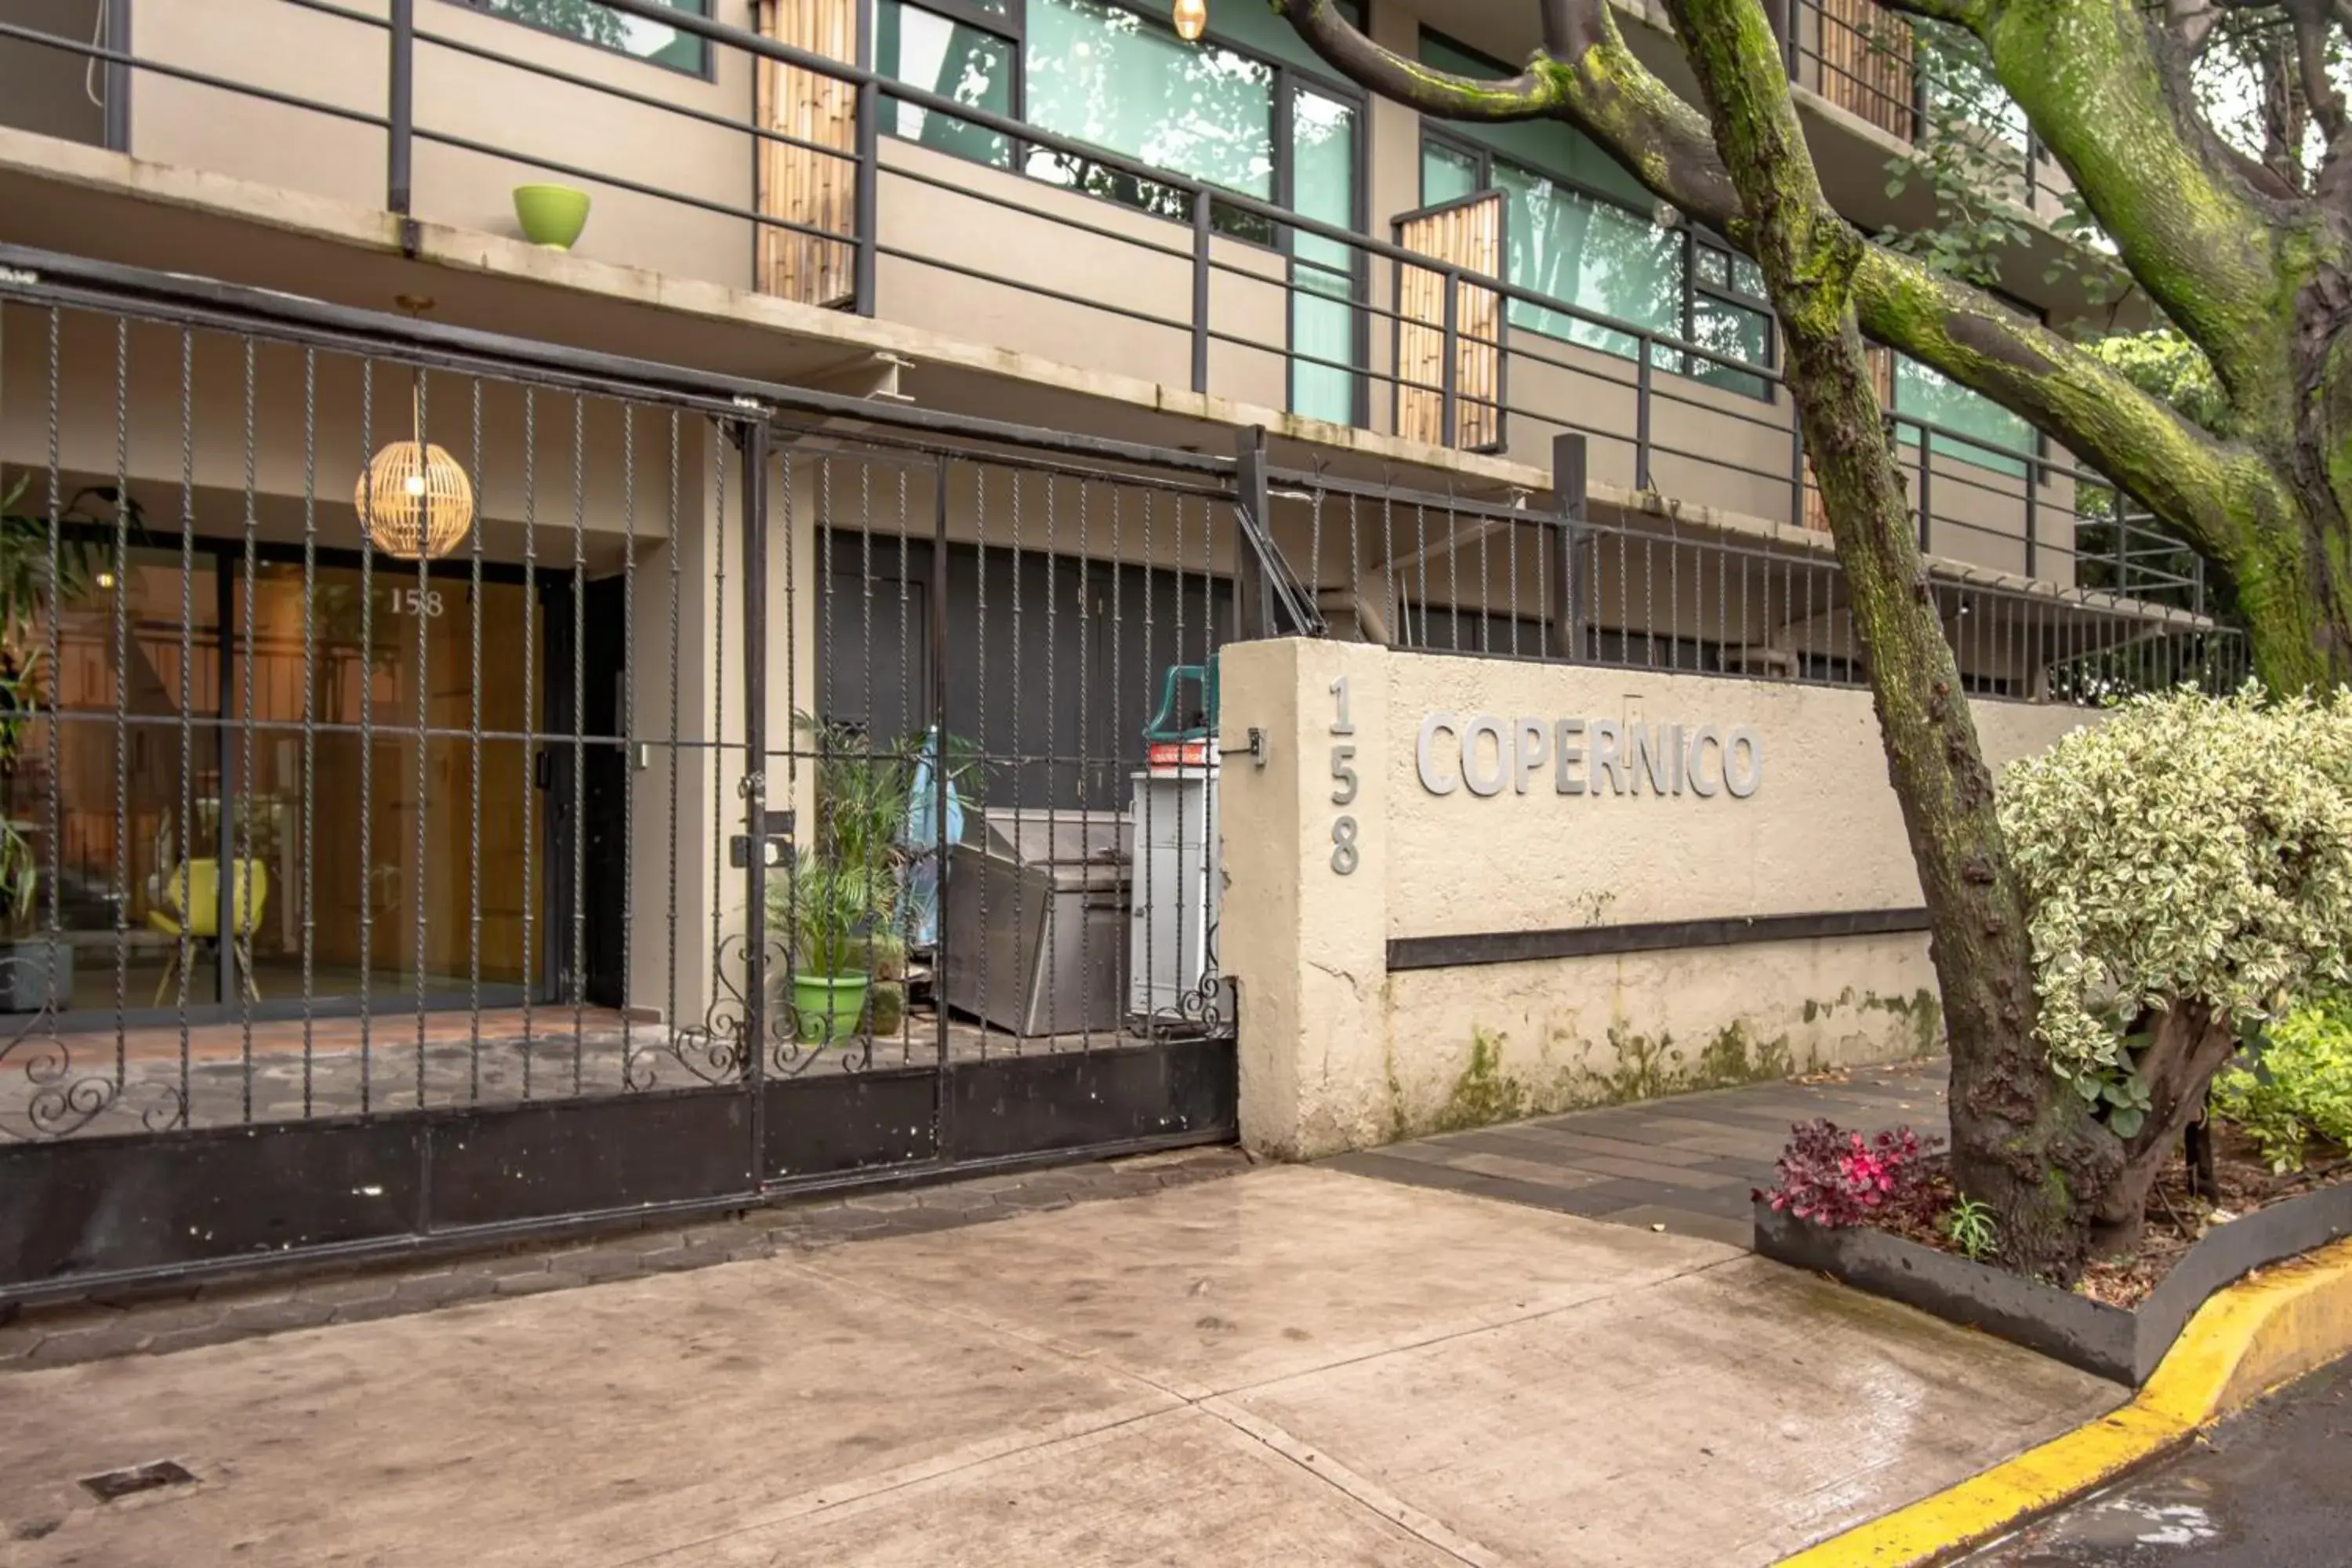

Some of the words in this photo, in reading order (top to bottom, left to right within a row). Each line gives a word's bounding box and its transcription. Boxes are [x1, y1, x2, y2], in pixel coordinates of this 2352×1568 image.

[390, 587, 445, 617] 158
[1330, 675, 1359, 875] 158
[1415, 711, 1762, 798] COPERNICO
